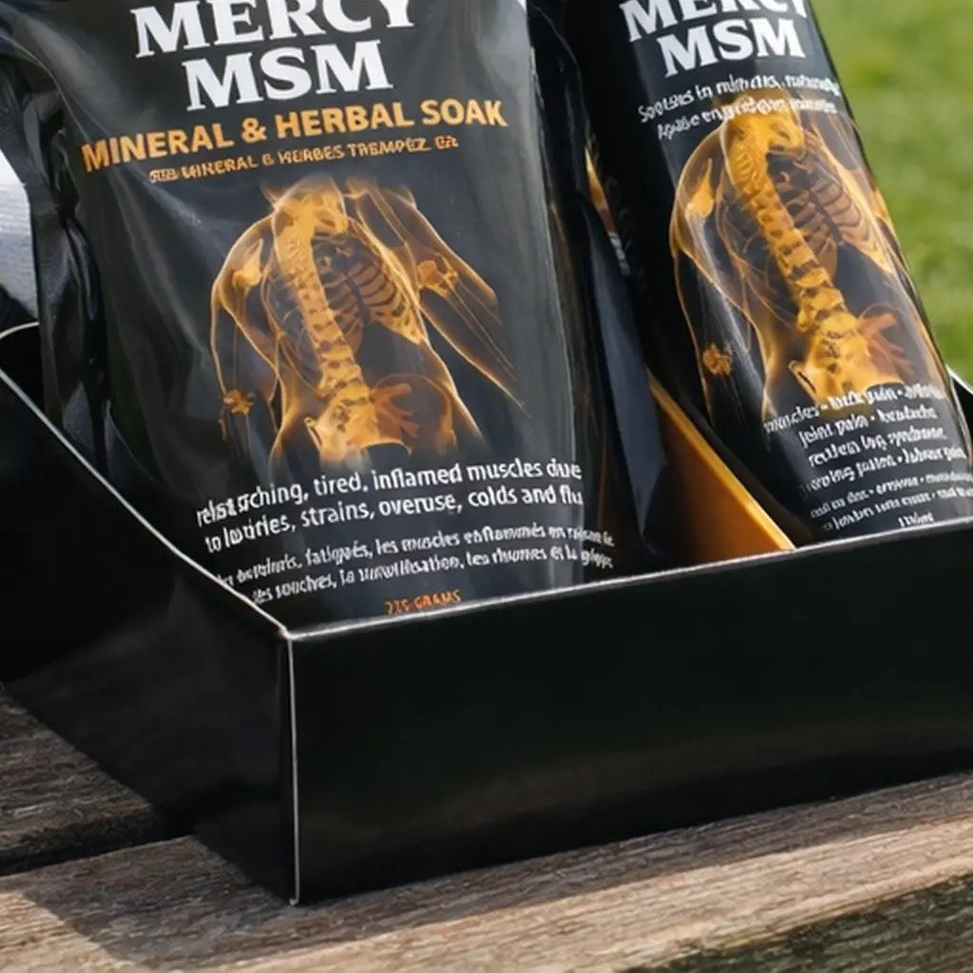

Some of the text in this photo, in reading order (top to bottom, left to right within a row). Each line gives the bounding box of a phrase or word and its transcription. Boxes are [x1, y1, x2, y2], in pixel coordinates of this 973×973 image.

[656, 17, 807, 78] MSM
[181, 39, 394, 111] MSM
[82, 98, 508, 173] MINERAL & HERBAL SOAK
[372, 463, 463, 491] inflamed
[466, 458, 544, 483] muscles
[546, 458, 583, 479] due
[301, 501, 376, 527] strains,
[379, 492, 462, 517] overuse,
[468, 486, 518, 507] colds
[521, 484, 558, 504] and
[559, 484, 585, 506] flu
[375, 538, 400, 555] les
